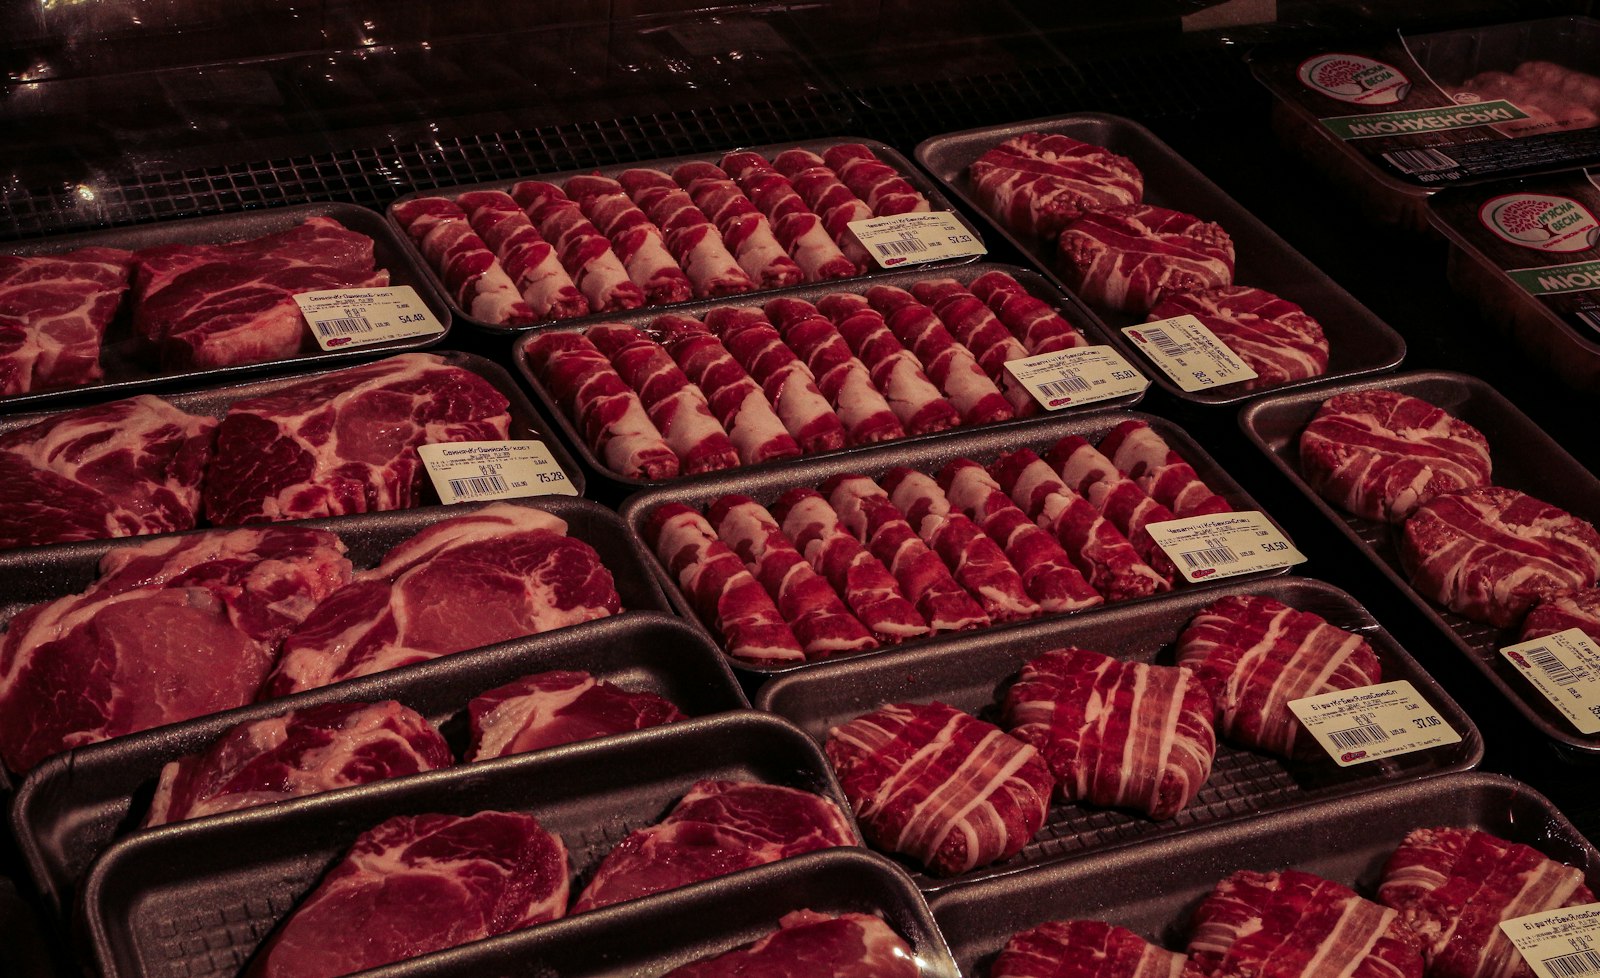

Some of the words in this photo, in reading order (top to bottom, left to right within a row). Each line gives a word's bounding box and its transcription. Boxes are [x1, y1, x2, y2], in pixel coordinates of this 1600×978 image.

[1348, 108, 1514, 136] МЮНХЕНСЬКІ
[1538, 201, 1575, 223] М'ЯСНА
[1551, 212, 1583, 231] ВЕСНА
[948, 235, 972, 243] 57.33
[399, 314, 425, 323] 54.48
[1111, 370, 1137, 380] 55.81
[536, 472, 564, 483] 75.28
[1261, 542, 1288, 552] 54.50
[1412, 716, 1441, 728] 37.06
